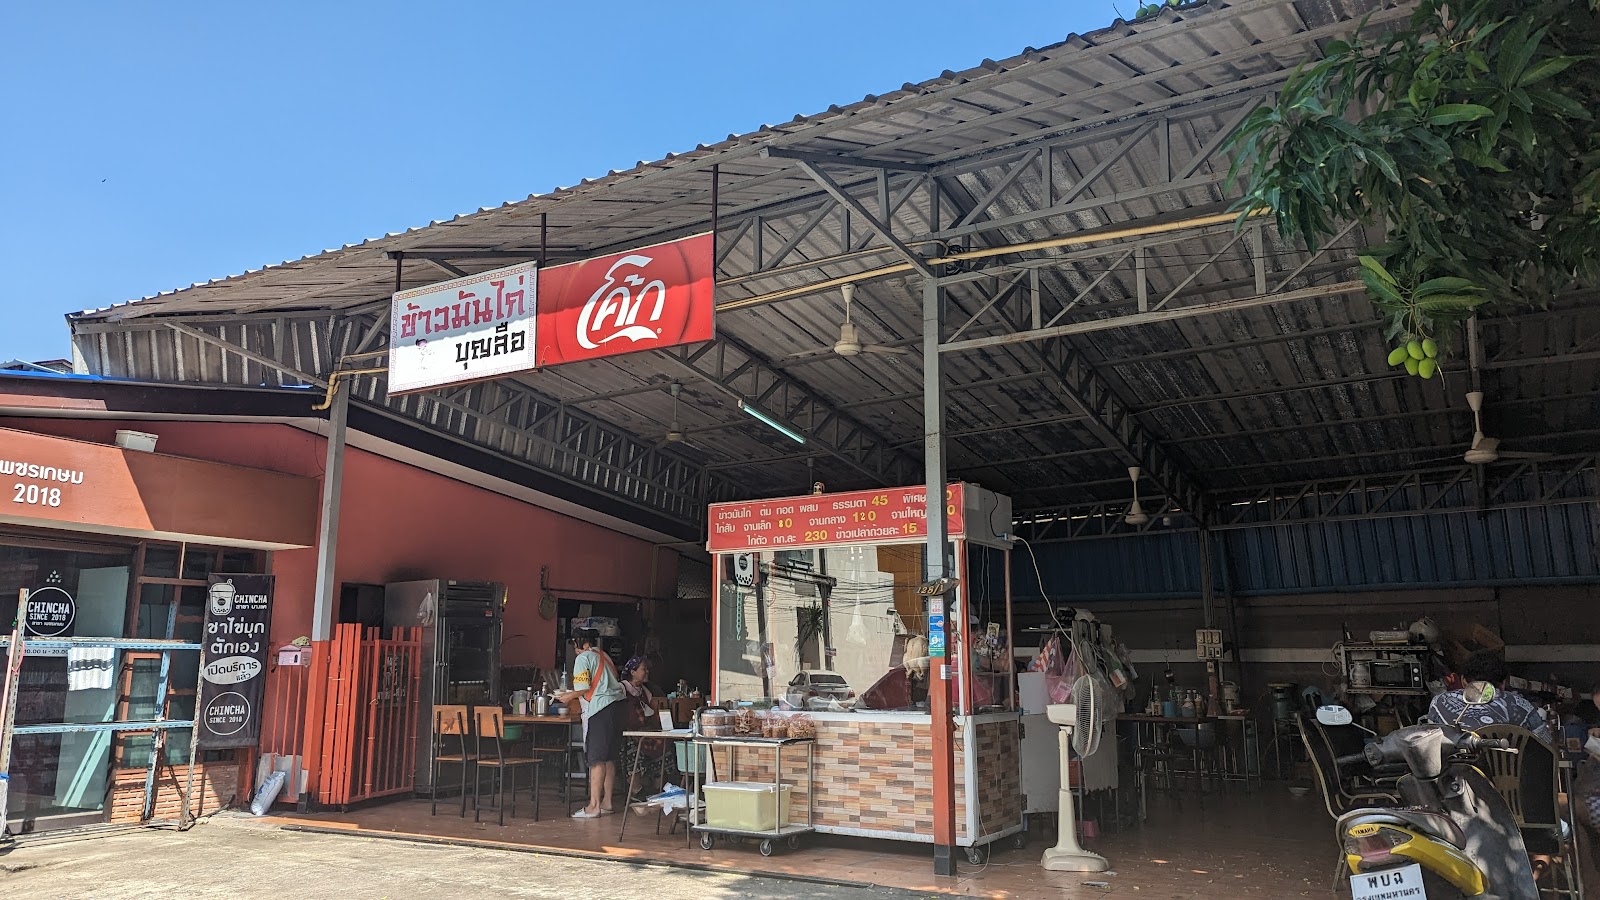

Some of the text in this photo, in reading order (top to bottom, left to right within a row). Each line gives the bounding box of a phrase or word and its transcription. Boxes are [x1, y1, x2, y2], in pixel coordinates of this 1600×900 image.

[401, 275, 526, 339] ข้าวมันไก่
[455, 321, 526, 371] บุญลือ
[12, 483, 62, 508] 2018
[718, 505, 752, 520] ข้าวมันไก่
[759, 504, 772, 517] ต้ม
[776, 506, 794, 515] ทอด
[799, 503, 819, 513] ผสม
[832, 498, 867, 510] ธรรมดา
[871, 494, 889, 506] 45
[715, 521, 736, 534] ไก่สับ
[743, 520, 772, 532] จานเล็ก
[778, 518, 793, 529] 80
[808, 514, 846, 527] จานกลาง
[852, 510, 877, 523] 120
[747, 522, 918, 546] ไก่ตัว กก.ละ 230 ข้าวเปล่าถ้วยละ 15
[234, 594, 268, 604] CHINCHA
[27, 601, 70, 614] CHINCHA
[29, 612, 67, 621] SINCE 2018
[207, 616, 265, 639] ชาไข่มุก
[210, 637, 260, 654] ตักเอง
[207, 661, 258, 676] เปิดบริการ
[235, 671, 251, 681] แล้ว
[209, 704, 246, 716] CHINCHA
[209, 716, 227, 724] SINCE
[1354, 827, 1375, 835] YAMAHA
